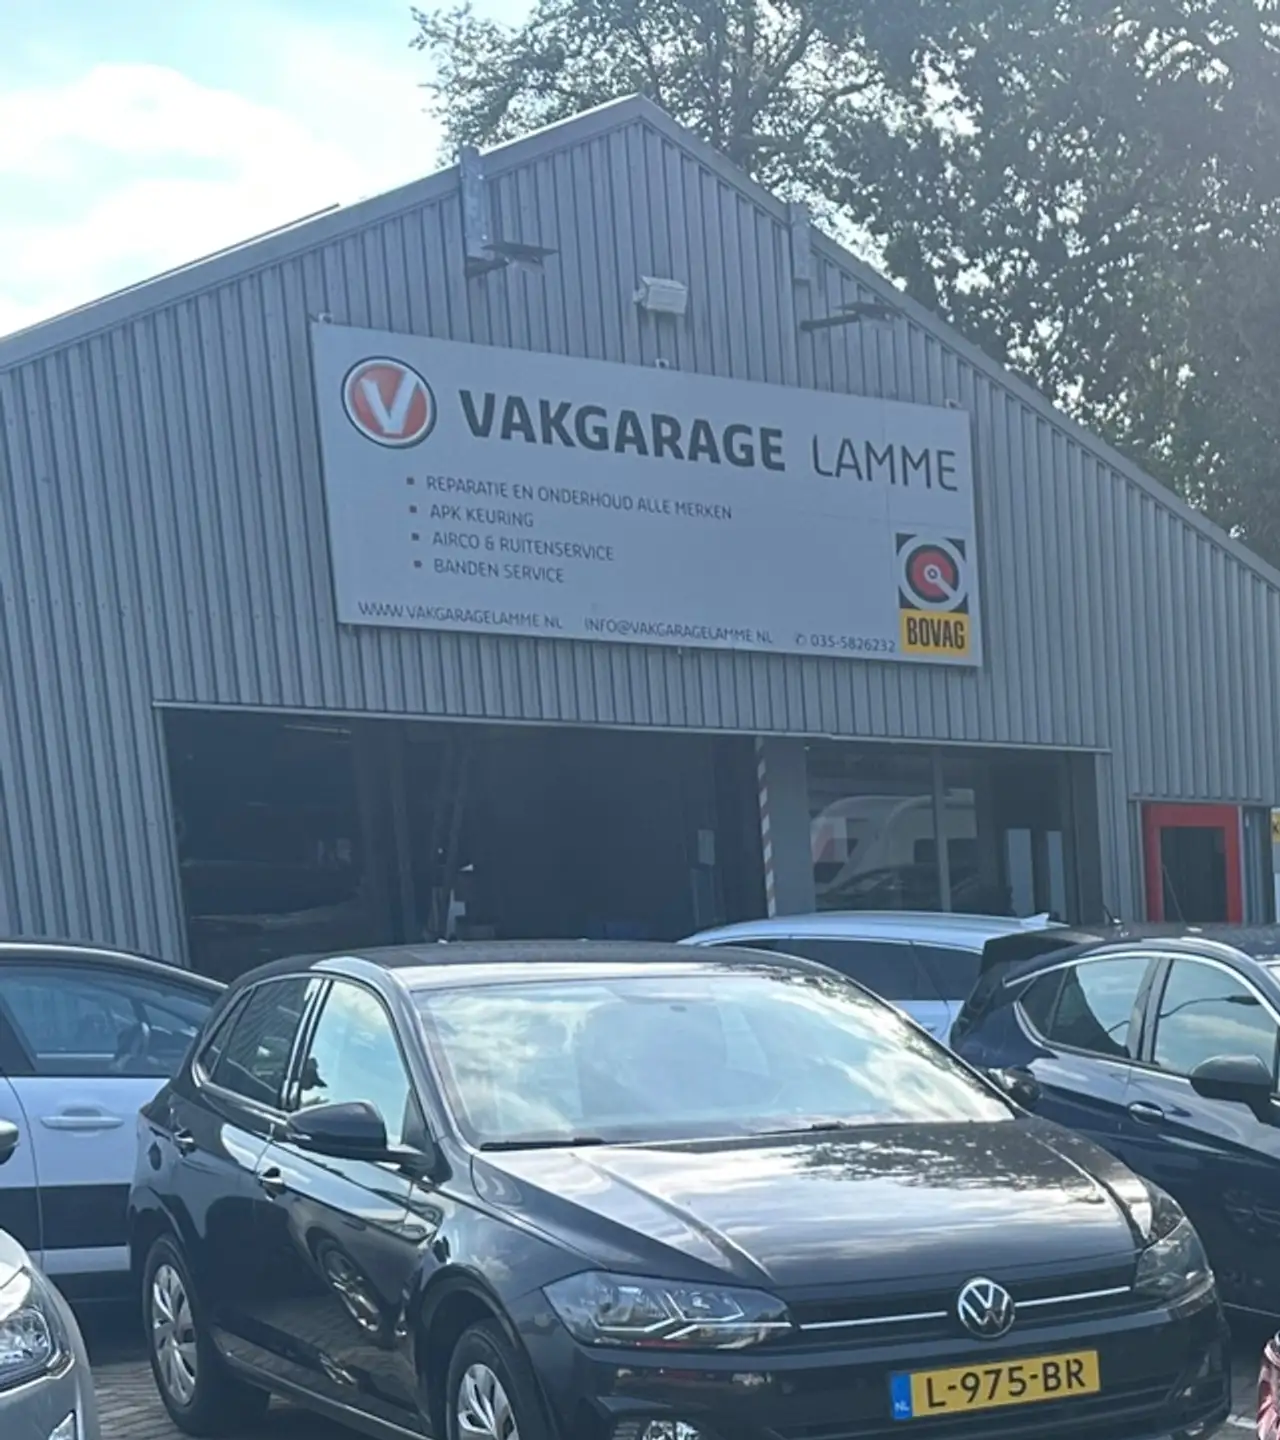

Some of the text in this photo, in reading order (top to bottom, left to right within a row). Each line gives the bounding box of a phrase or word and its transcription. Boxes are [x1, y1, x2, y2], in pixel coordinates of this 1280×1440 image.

[458, 389, 958, 492] VAKGARAGE LAMME
[426, 475, 732, 520] REPARATIE EN ONDERHOUD ALLE MERKEN
[430, 503, 534, 527] APK KEURING
[432, 531, 614, 561] AIRCO & RUITENSERVICE
[433, 558, 564, 583] BANDEN SERVICE
[810, 634, 896, 653] 035-5826232
[906, 616, 965, 650] BOVAG
[926, 1358, 1086, 1409] L-975-BR
[894, 1402, 910, 1412] NL
